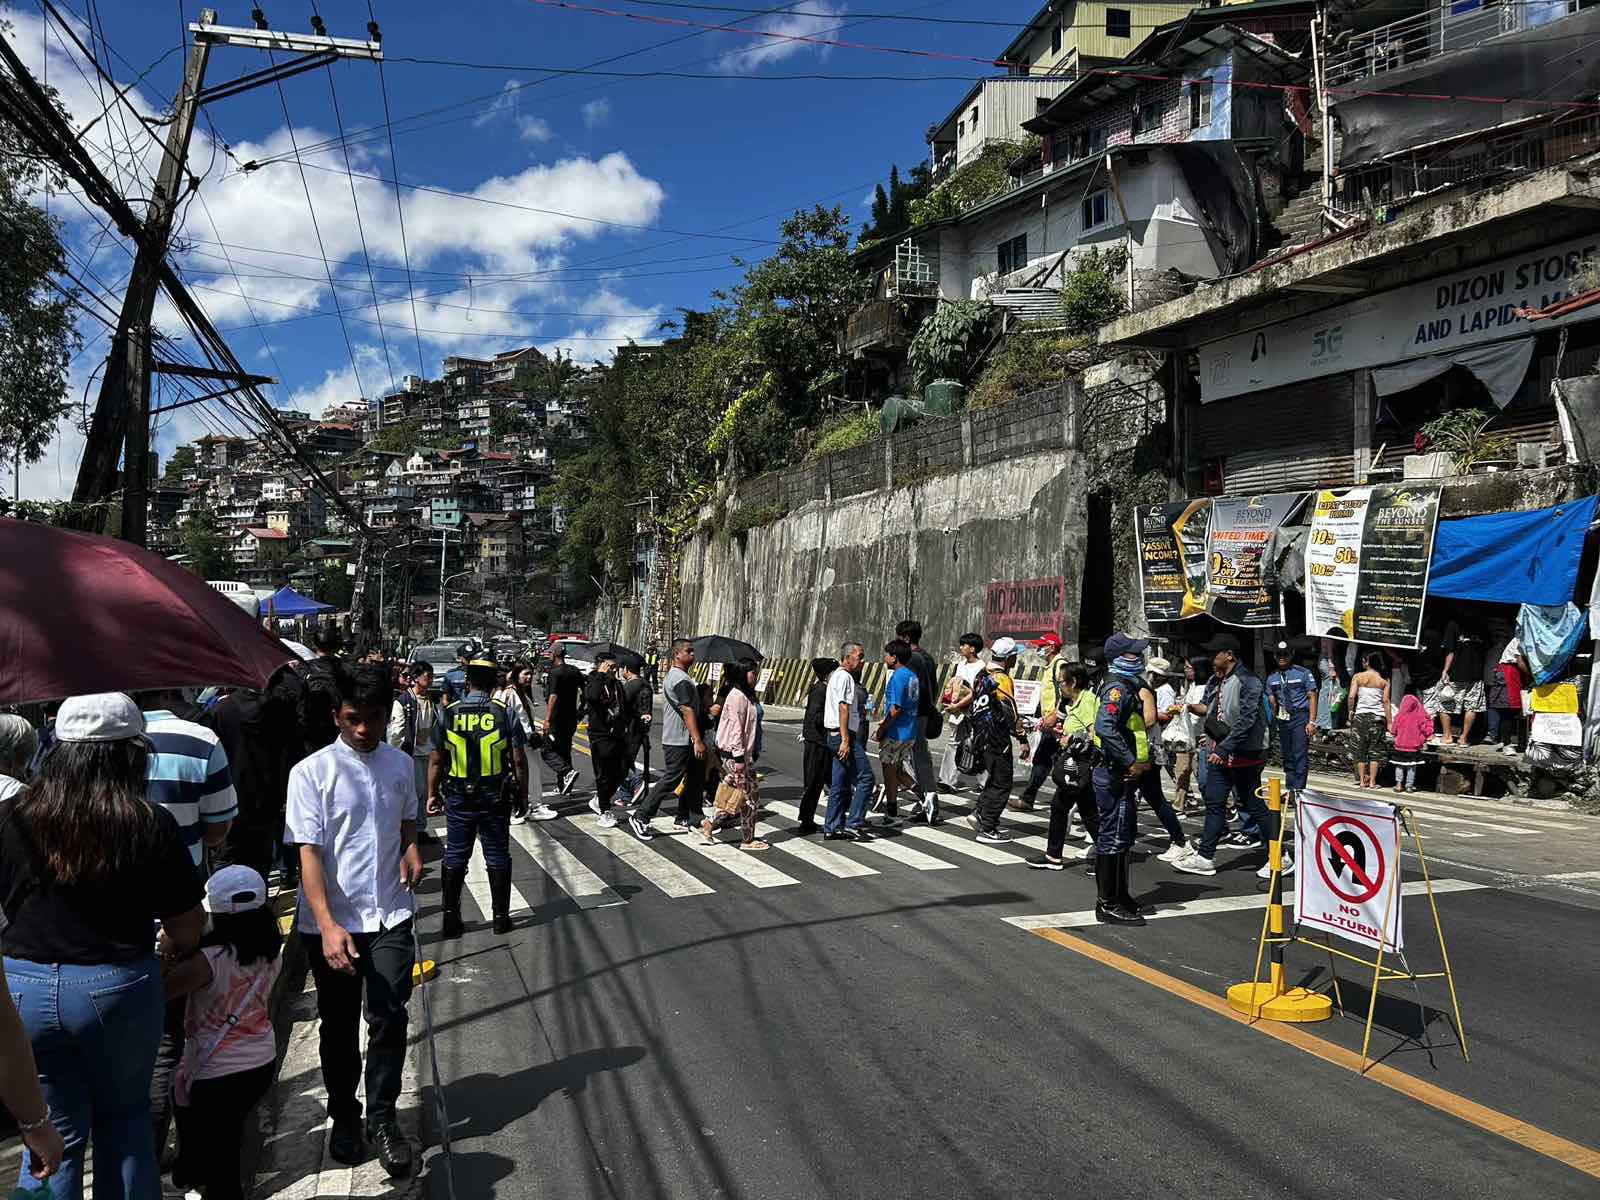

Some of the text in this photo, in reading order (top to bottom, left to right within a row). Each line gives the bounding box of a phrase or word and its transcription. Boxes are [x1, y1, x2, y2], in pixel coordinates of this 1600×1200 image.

[1436, 270, 1505, 310] DIZON
[1415, 318, 1452, 344] AND
[1377, 507, 1428, 518] BEYOND
[1243, 530, 1266, 540] TIME
[990, 585, 1060, 614] NO PARKING
[453, 713, 495, 731] HPG
[1339, 904, 1360, 917] NO
[1322, 912, 1378, 937] U-TURN
